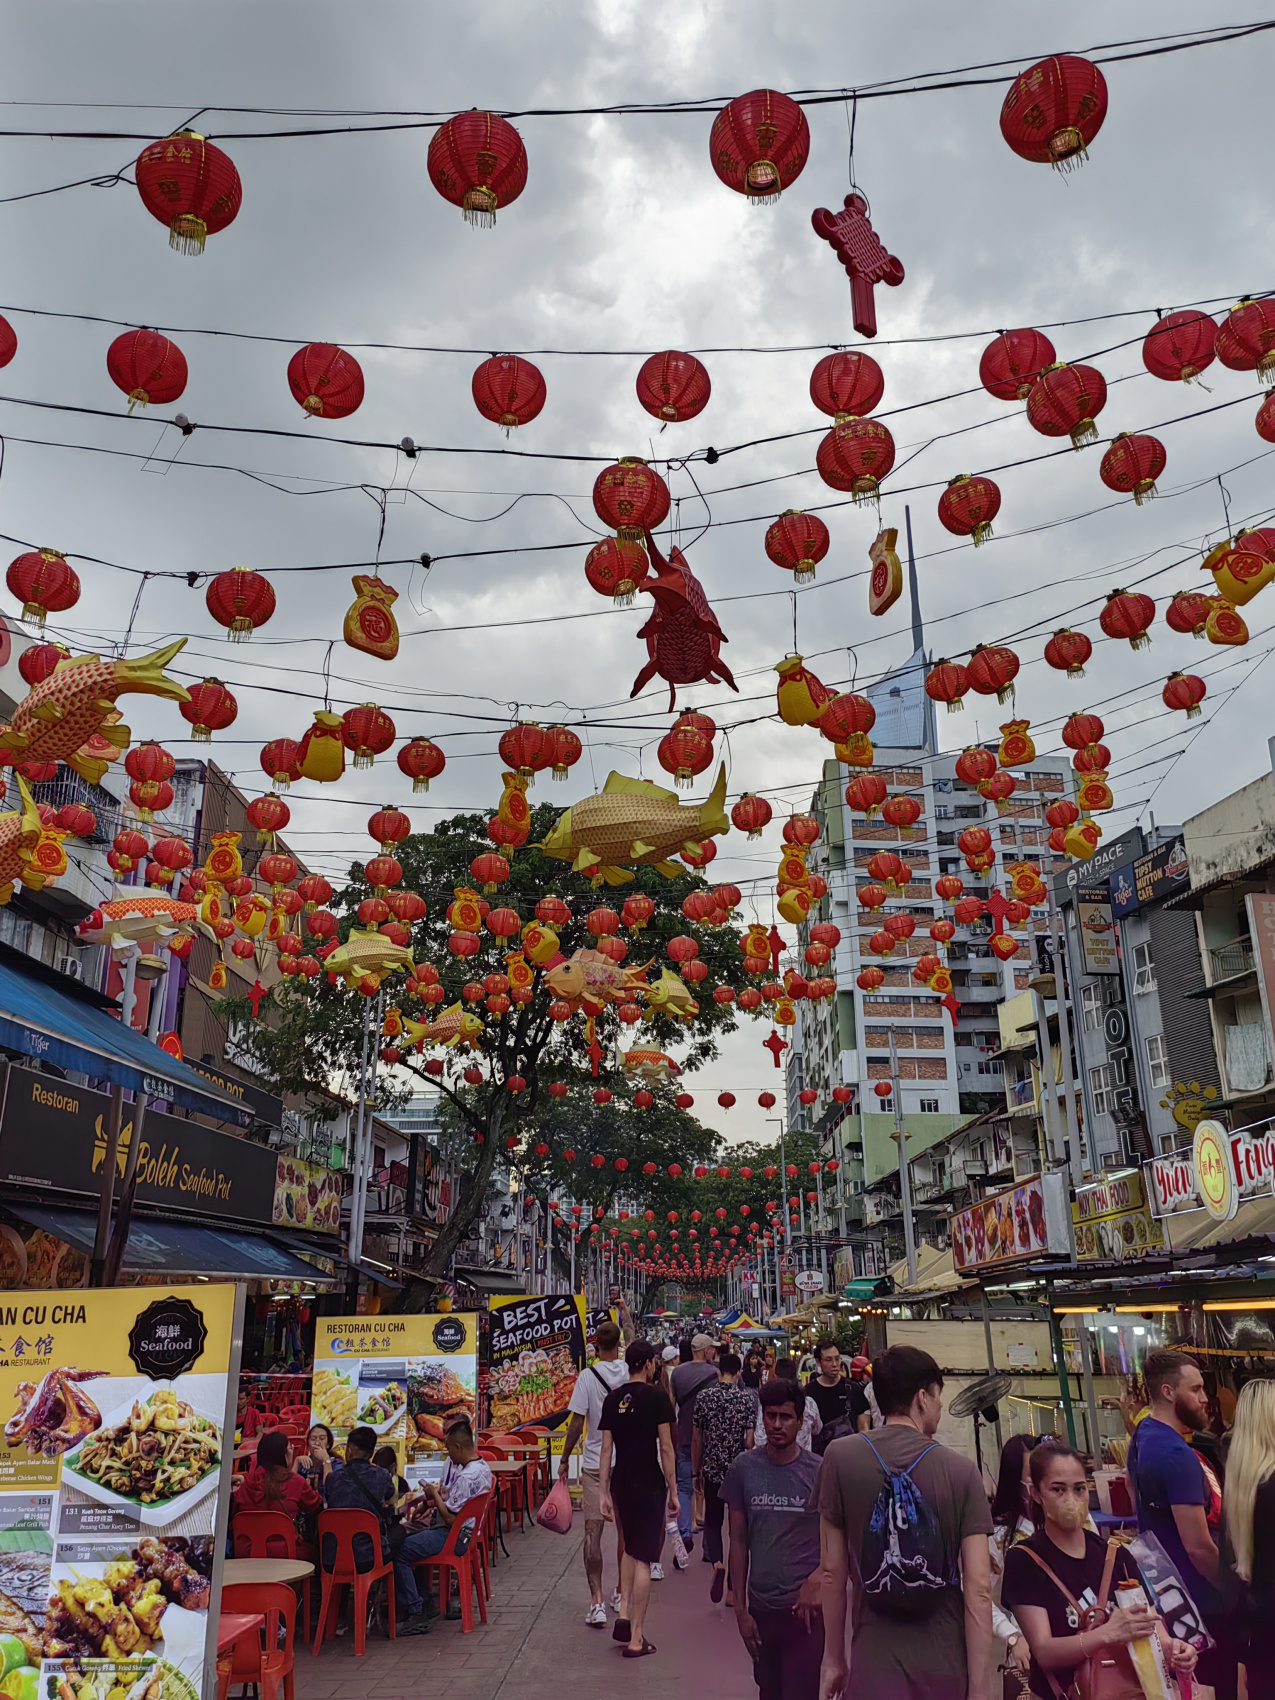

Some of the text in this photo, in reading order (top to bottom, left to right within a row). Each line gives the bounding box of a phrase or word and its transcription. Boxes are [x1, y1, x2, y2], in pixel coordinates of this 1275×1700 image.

[1158, 846, 1166, 855] BAR
[1078, 862, 1093, 878] MY
[1134, 861, 1152, 877] TIPSY
[1136, 867, 1163, 891] MUTTON
[1114, 887, 1133, 905] Tiger
[1137, 886, 1154, 901] CAFE
[31, 1033, 50, 1053] Tiger
[32, 1083, 79, 1114] Restoran
[136, 1142, 232, 1200] Boleh Seafood Pot
[1155, 1165, 1192, 1205] Yuen
[1109, 1179, 1131, 1210] FOOD
[743, 1271, 756, 1280] KK
[22, 1306, 47, 1325] CU
[51, 1304, 87, 1324] CHA
[502, 1299, 549, 1331] BEST
[326, 1322, 406, 1334] RESTORAN CU CHA
[492, 1313, 578, 1351] SEAFOOD POT
[0, 1333, 54, 1358] 食馆
[140, 1338, 193, 1352] Seafood
[537, 1334, 565, 1347] MUST TRY
[493, 1343, 532, 1360] IN MALAYSIA
[10, 1358, 51, 1367] RESTAURANT
[751, 1493, 789, 1506] adidas
